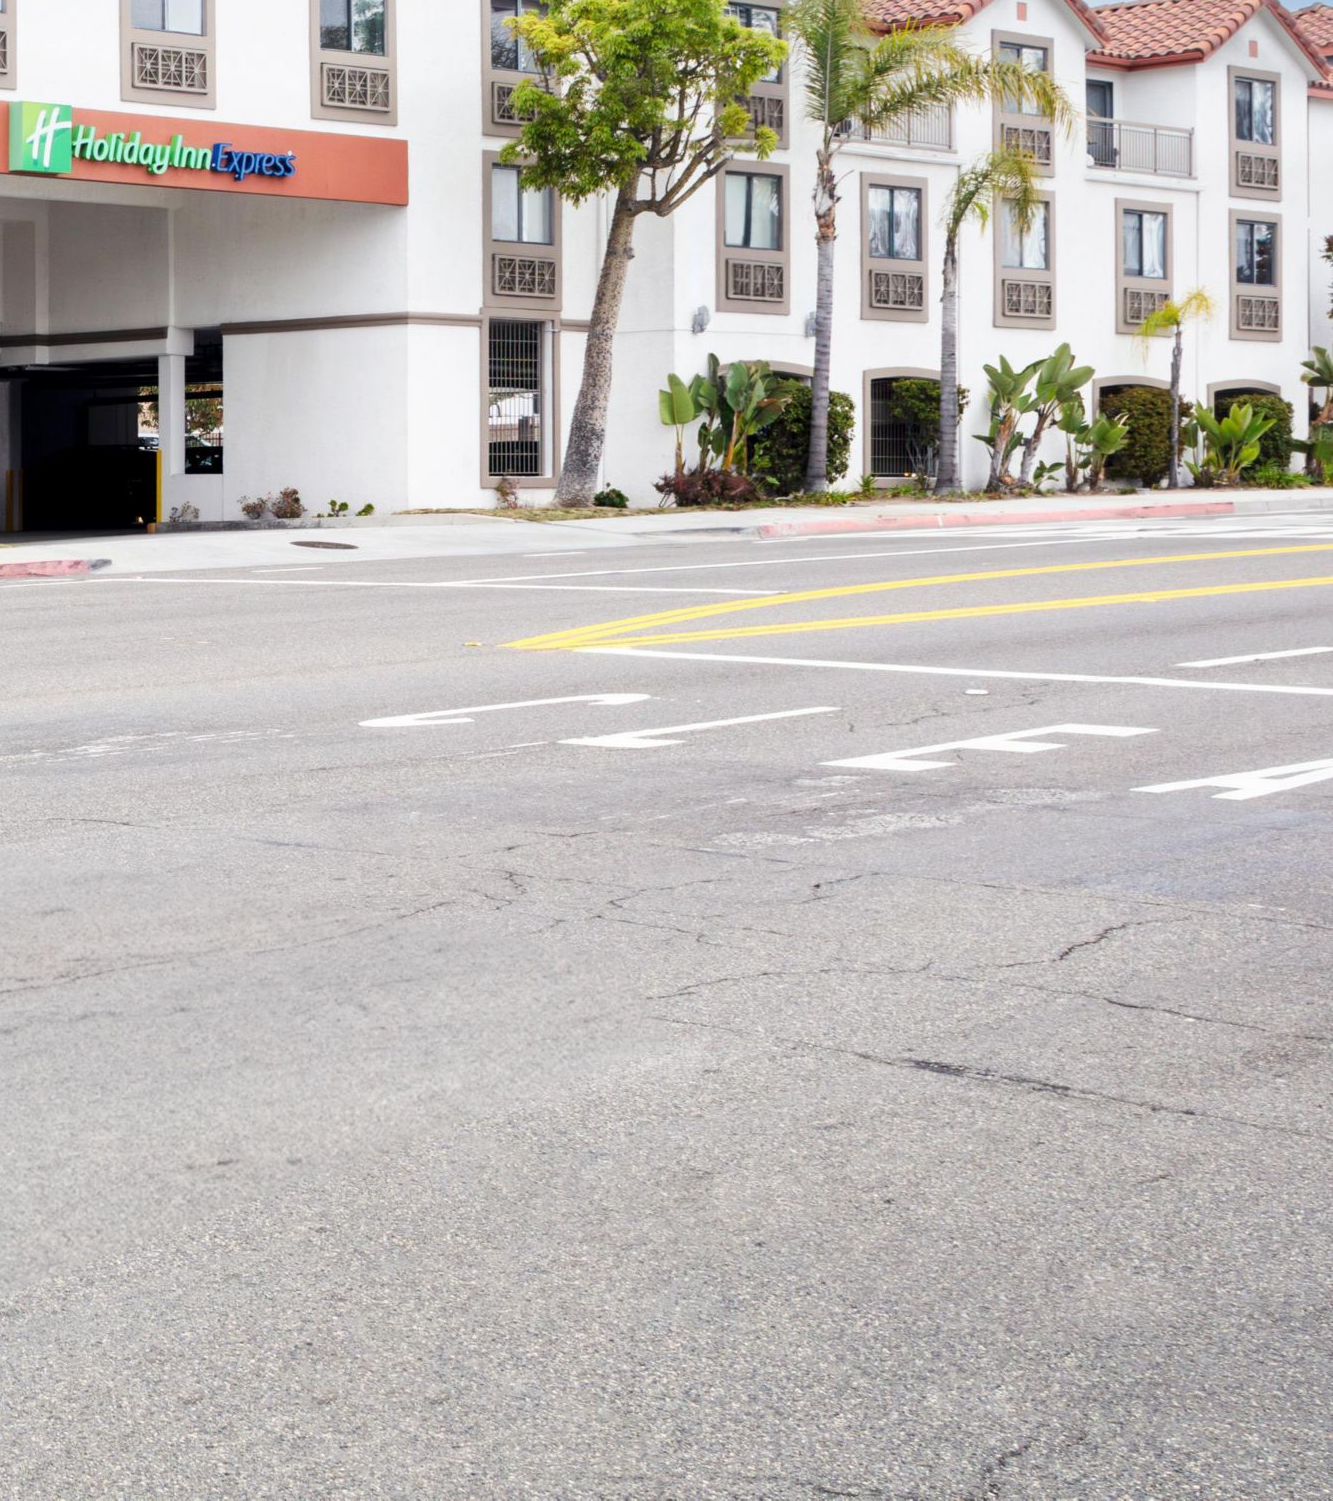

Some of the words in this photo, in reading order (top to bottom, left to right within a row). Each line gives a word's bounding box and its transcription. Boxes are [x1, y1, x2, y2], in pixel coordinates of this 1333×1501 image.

[72, 124, 171, 175] Holiday
[169, 134, 212, 171] Inn
[212, 143, 296, 181] Express
